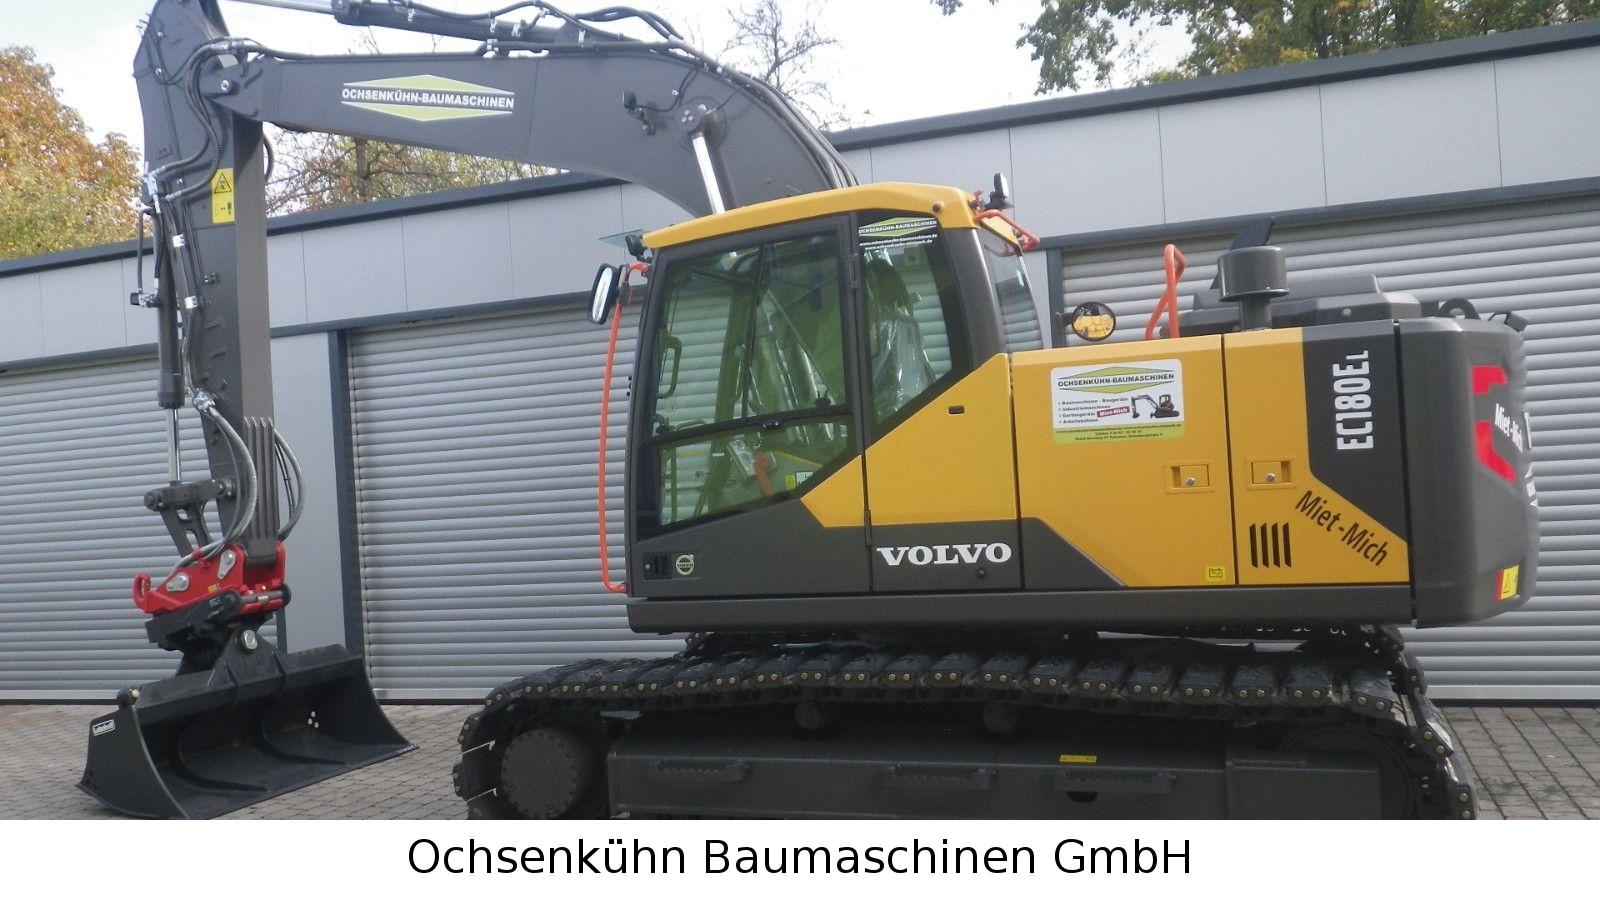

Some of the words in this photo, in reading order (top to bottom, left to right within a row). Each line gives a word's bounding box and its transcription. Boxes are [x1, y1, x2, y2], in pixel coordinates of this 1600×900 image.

[341, 88, 515, 109] OCHSENKÜHN-BAUMASCHINEN
[1294, 490, 1388, 567] Miet-Mich
[876, 542, 1012, 566] VOLVO
